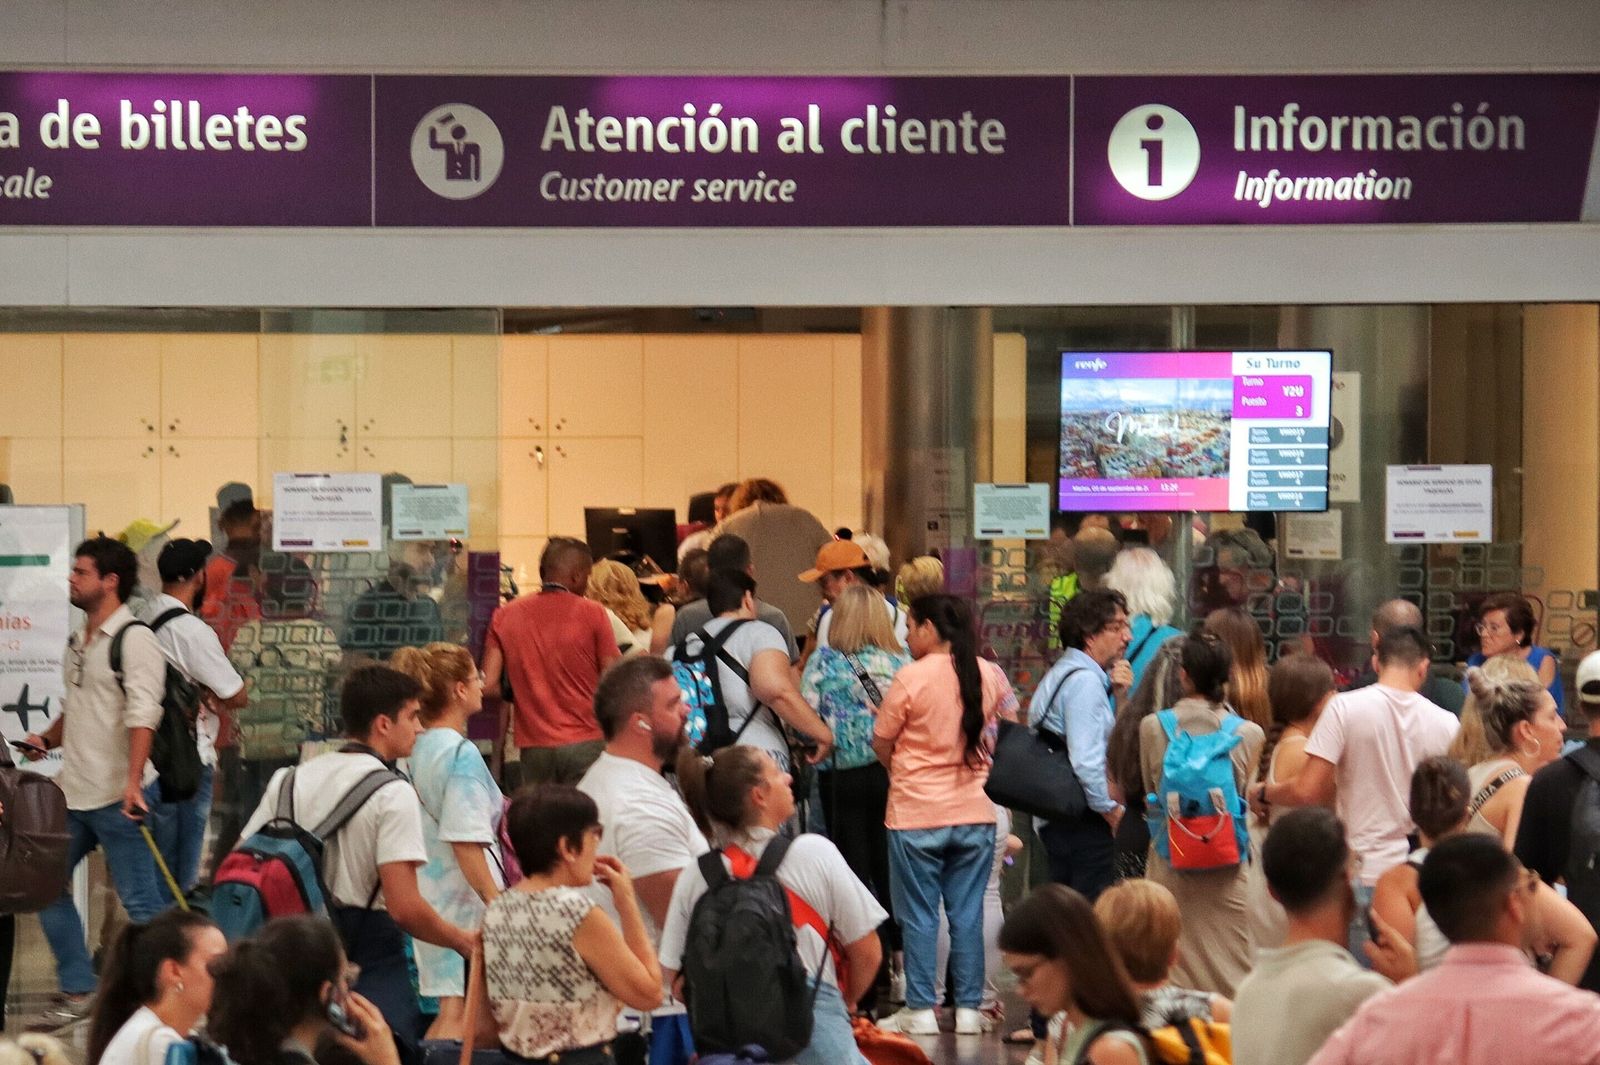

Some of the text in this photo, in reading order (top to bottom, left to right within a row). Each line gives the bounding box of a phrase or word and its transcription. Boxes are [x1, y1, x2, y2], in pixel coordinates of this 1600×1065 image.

[40, 98, 102, 150] de
[119, 99, 308, 152] billetes
[541, 102, 1006, 156] Atención al cliente
[1233, 101, 1526, 153] Información
[539, 170, 797, 204] Customer service
[1233, 168, 1413, 209] Information
[1246, 357, 1301, 369] Su Turno
